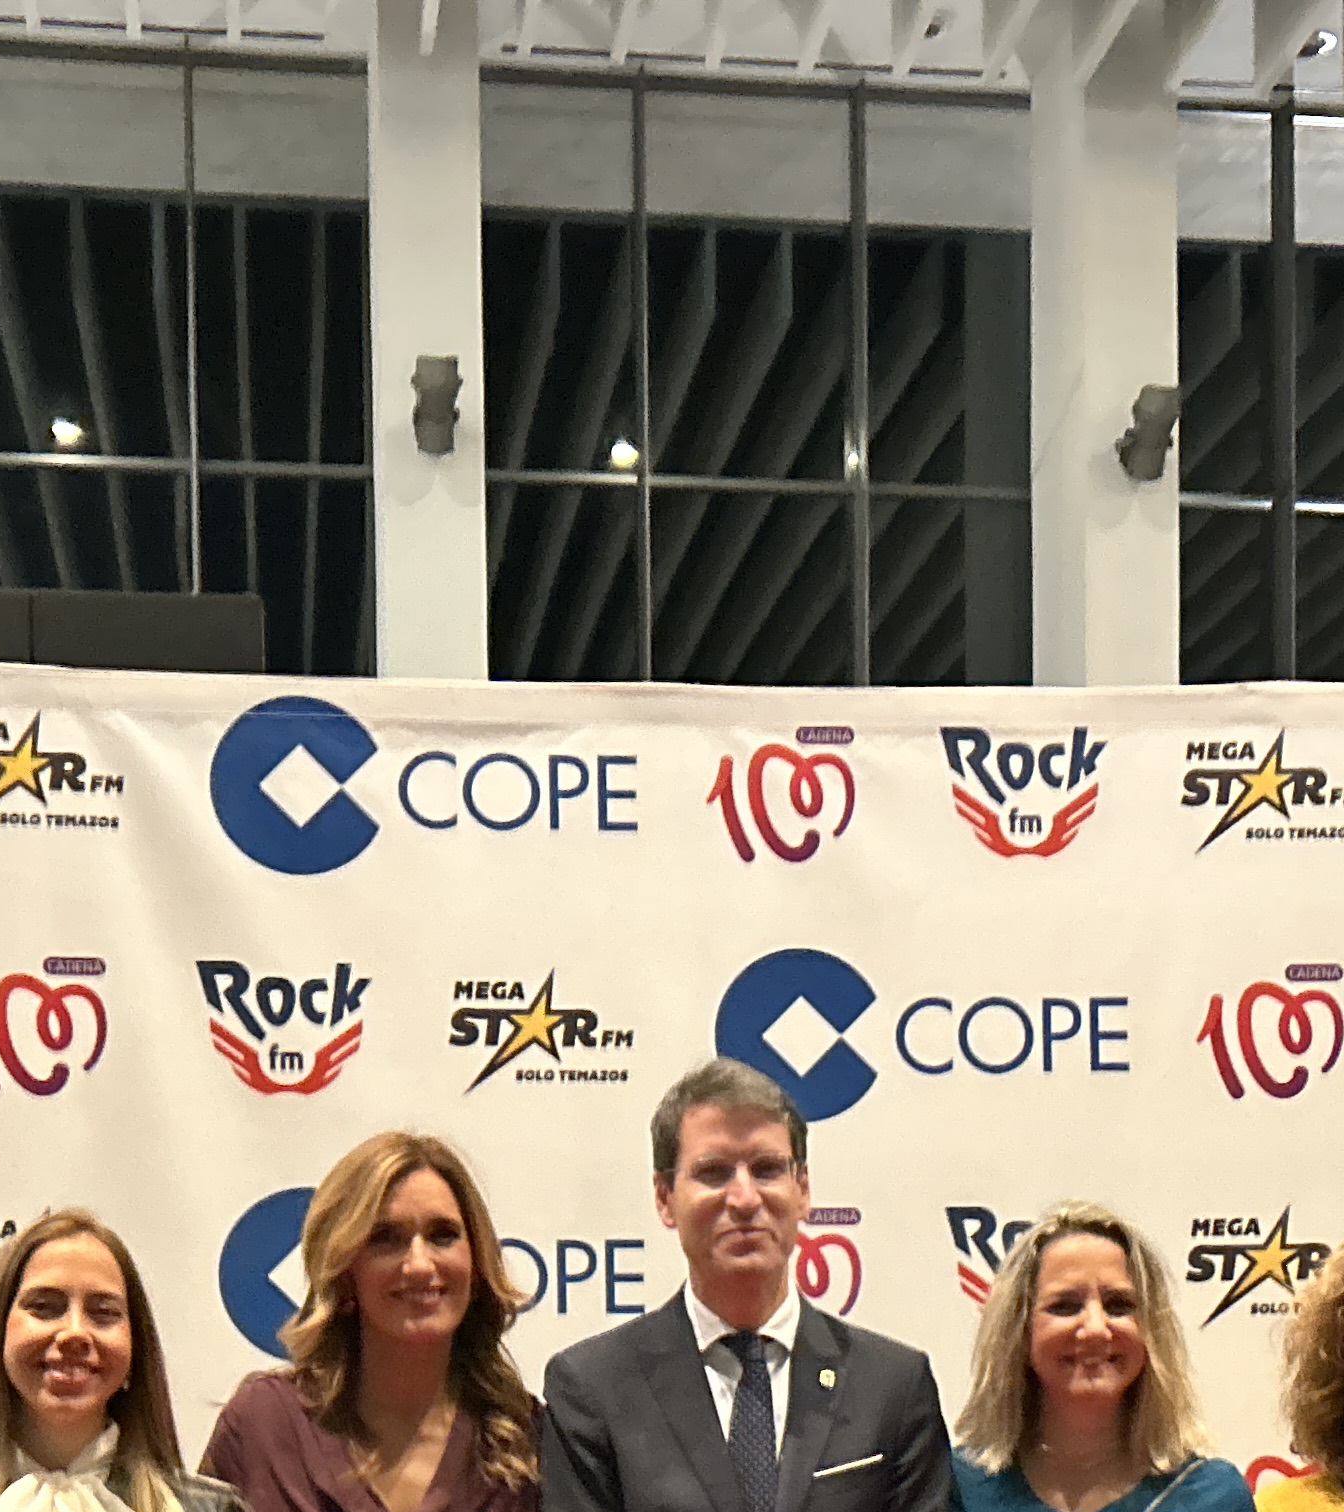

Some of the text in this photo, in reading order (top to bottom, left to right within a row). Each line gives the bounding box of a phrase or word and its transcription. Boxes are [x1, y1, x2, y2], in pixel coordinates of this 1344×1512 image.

[1187, 741, 1254, 761] MEGA
[940, 726, 1105, 805] Rock
[91, 774, 123, 794] FM
[399, 751, 638, 831] COPE
[0, 812, 119, 828] SOLO TEMAZOS
[1009, 808, 1042, 834] fm
[1246, 827, 1283, 839] SOLO
[196, 961, 372, 1038] Rock
[454, 981, 525, 1000] MEGA
[601, 1030, 634, 1047] FM
[896, 996, 1129, 1075] COPE
[269, 1046, 303, 1072] fm
[516, 1070, 628, 1082] SOLO TEMAZOS
[1191, 1217, 1261, 1237] MEGA
